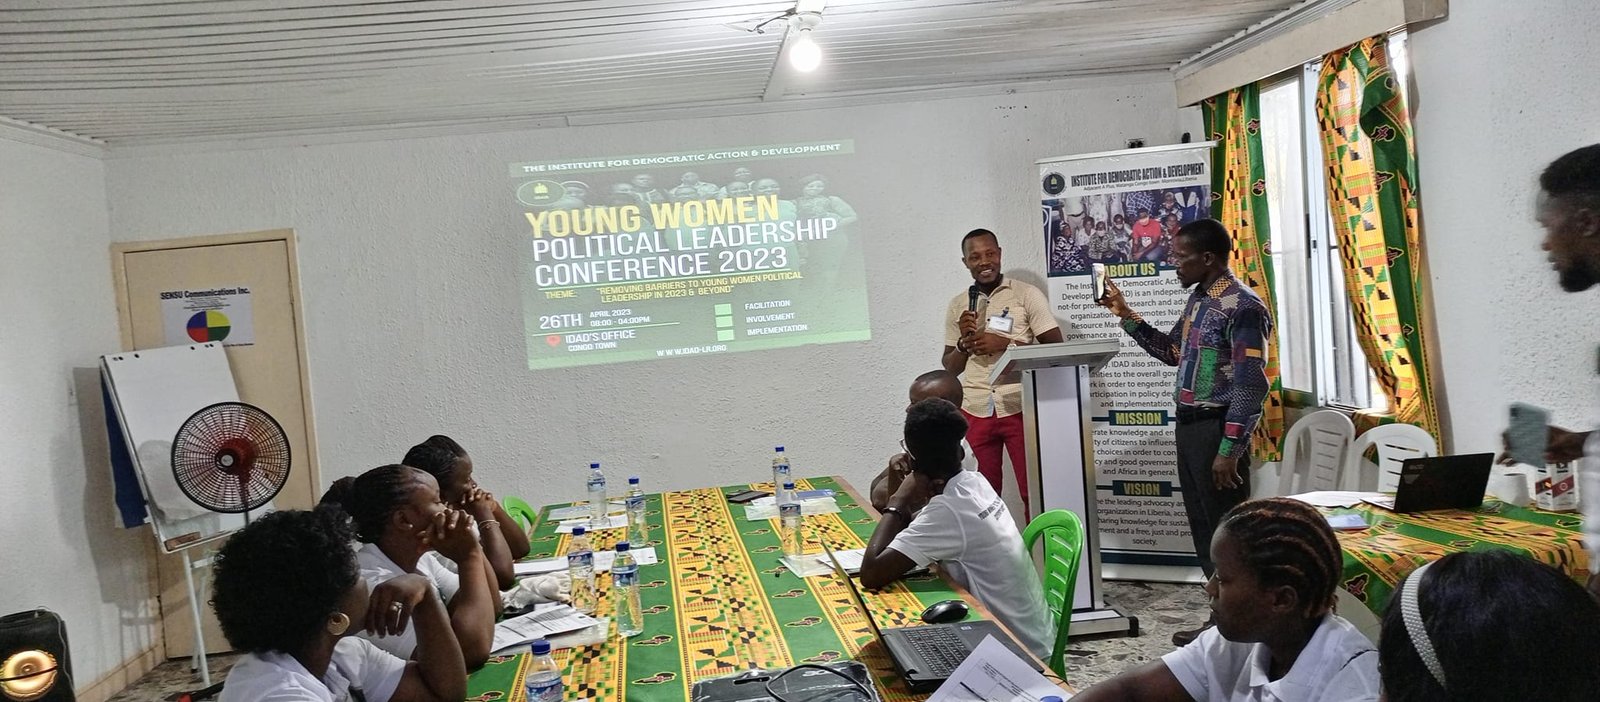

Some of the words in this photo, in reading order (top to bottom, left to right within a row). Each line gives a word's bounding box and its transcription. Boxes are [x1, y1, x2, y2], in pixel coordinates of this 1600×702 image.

[523, 164, 546, 173] THE
[548, 161, 606, 171] INSTITUTE
[608, 159, 630, 167] FOR
[632, 154, 705, 166] DEMOCRATIC
[708, 150, 748, 160] ACTION
[762, 144, 841, 156] DEVELOPMENT
[1071, 174, 1097, 187] INSTITUTE
[1098, 172, 1108, 185] FOR
[1108, 168, 1142, 185] DEMOCRATIC
[1142, 166, 1161, 181] ACTION
[1162, 168, 1167, 178] &
[1168, 162, 1205, 178] DEVELOPMENT
[525, 205, 641, 239] YOUNG
[652, 195, 780, 231] WOMEN
[532, 231, 669, 261] POLITICAL
[676, 218, 838, 249] LEADERSHIP
[535, 253, 710, 287] CONFERENCE
[719, 246, 788, 273] 2023
[1104, 264, 1138, 278] ABOUT
[1140, 262, 1156, 276] US
[645, 279, 686, 292] BARRIERS
[688, 278, 699, 288] TO
[700, 276, 729, 287] YOUNG
[730, 274, 762, 285] WOMEN
[762, 271, 803, 282] POLITICAL
[1122, 279, 1164, 287] Democratic
[160, 291, 183, 300] SENSU
[184, 288, 236, 298] Communications
[238, 287, 251, 295] Inc.
[601, 290, 652, 303] LEADERSHIP
[654, 290, 664, 299] IN
[665, 289, 687, 298] 2023
[1062, 293, 1094, 301] Develop
[1153, 288, 1195, 297] independe
[744, 300, 791, 311] FACILITATION
[1058, 302, 1081, 311] not-for
[1158, 298, 1172, 306] and
[1174, 298, 1188, 306] adv
[590, 310, 610, 319] APRIL
[612, 308, 632, 316] 2023
[746, 312, 796, 324] INVOLVEMENT
[1070, 312, 1114, 321] organization
[539, 313, 583, 330] 26TH
[590, 319, 612, 328] 08:00
[618, 316, 650, 325] 04:00PM
[1072, 322, 1103, 330] Resource
[747, 324, 808, 336] IMPLEMENTATION
[565, 332, 599, 344] IDAD'S
[601, 329, 636, 340] OFFICE
[594, 341, 617, 350] TOWN
[1112, 360, 1130, 368] IDAD
[1132, 360, 1145, 368] also
[1123, 370, 1134, 378] the
[1136, 370, 1161, 378] overall
[1163, 370, 1177, 379] gov
[1099, 380, 1106, 388] in
[1107, 380, 1126, 388] order
[1137, 380, 1171, 389] engender
[1130, 390, 1137, 398] in
[1138, 390, 1160, 399] policy
[1100, 400, 1114, 408] and
[1116, 400, 1175, 408] implementation.
[1116, 412, 1162, 425] MISSION
[1110, 429, 1148, 438] knowledge
[1102, 438, 1110, 446] of
[1148, 439, 1177, 447] influenc
[1097, 448, 1123, 456] choices
[1132, 448, 1152, 456] order
[1104, 458, 1117, 466] and
[1119, 458, 1138, 467] good
[1118, 467, 1138, 475] Africa
[1124, 482, 1160, 496] VISION
[1117, 498, 1142, 508] leading
[1143, 500, 1174, 508] advocacy
[1097, 508, 1139, 516] organization
[1120, 518, 1157, 527] knowledge
[1159, 518, 1168, 526] for
[1152, 529, 1165, 537] just
[1180, 530, 1192, 538] pro
